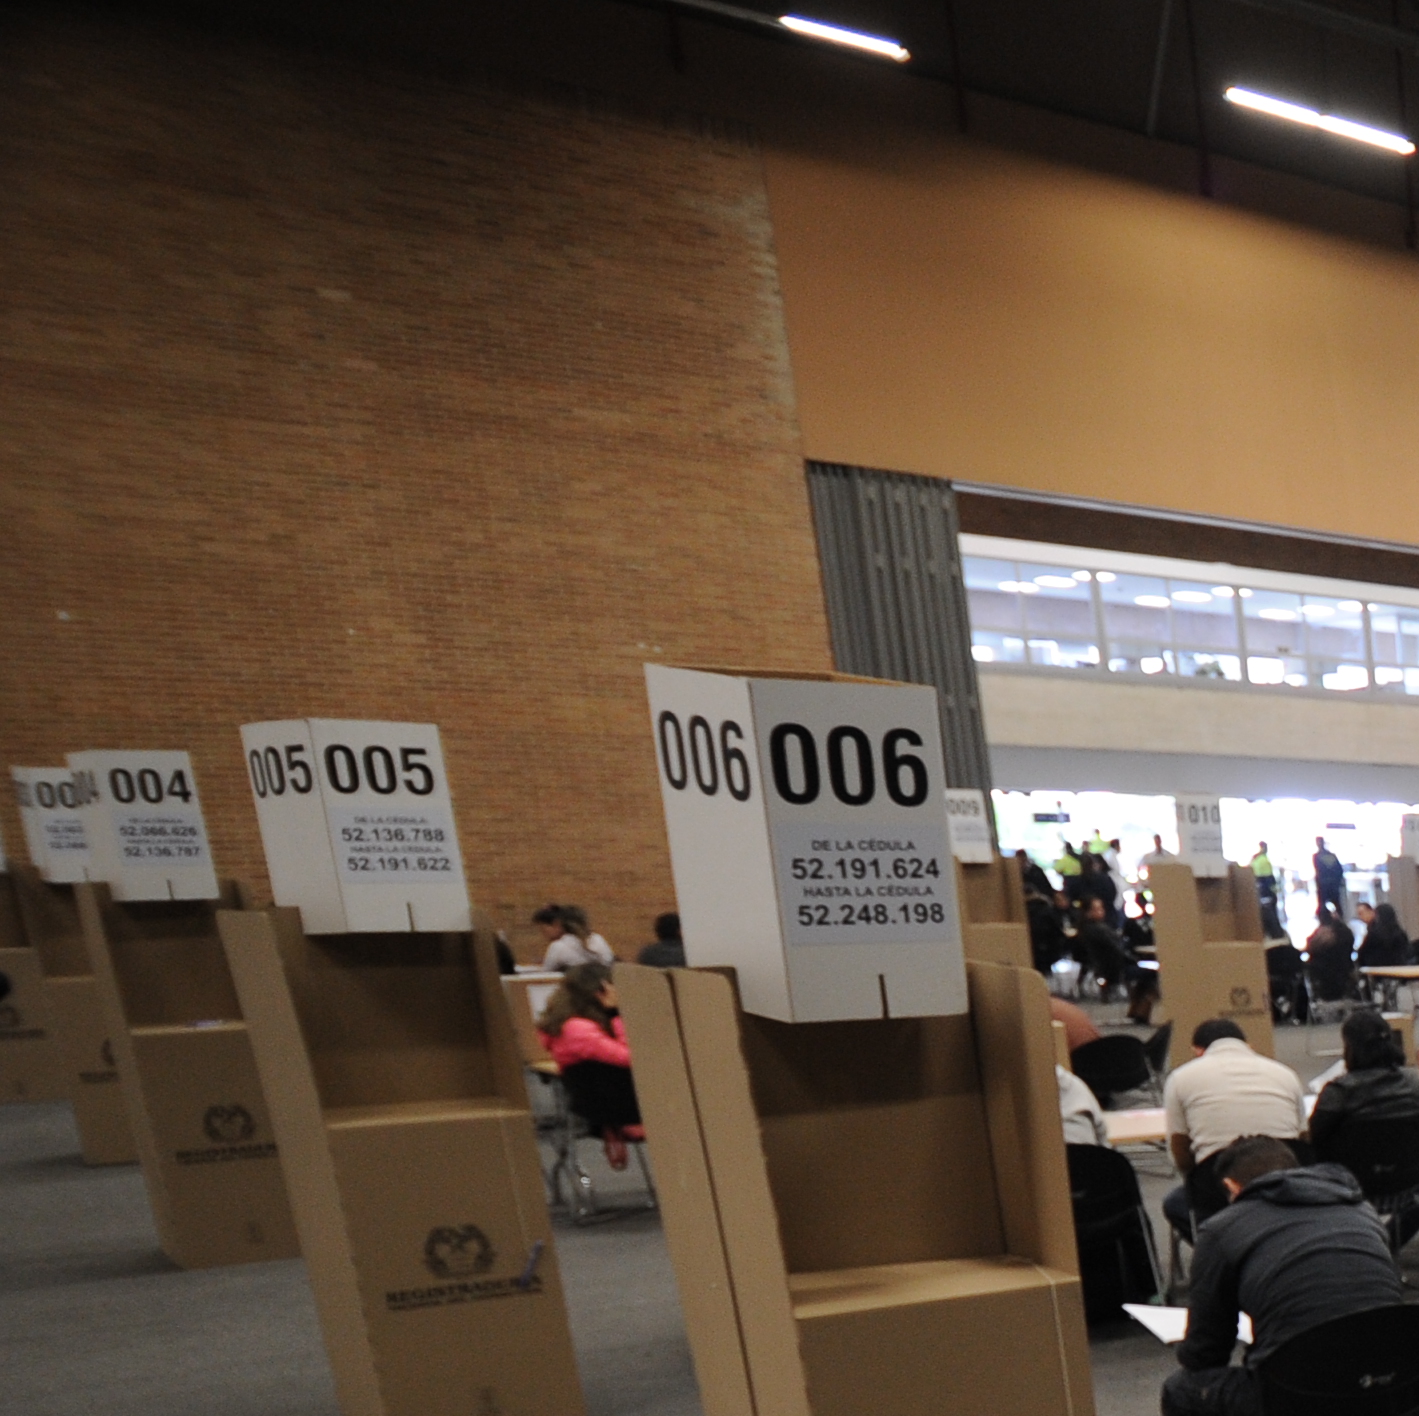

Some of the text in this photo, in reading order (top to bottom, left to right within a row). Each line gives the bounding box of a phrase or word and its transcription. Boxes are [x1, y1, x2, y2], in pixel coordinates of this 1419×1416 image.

[658, 710, 751, 801] 006
[769, 722, 930, 807] 006
[249, 744, 313, 799] 005
[324, 744, 435, 796] 005
[35, 781, 78, 810] 00
[108, 768, 192, 804] 004
[341, 827, 445, 842] 52.136.788
[811, 840, 831, 851] DE
[835, 840, 855, 851] LA
[347, 857, 451, 872] 52.191.622
[791, 857, 940, 880] 52.191.624
[803, 886, 851, 897] HASTA
[855, 886, 874, 897] LA
[798, 902, 945, 926] 52.248.198
